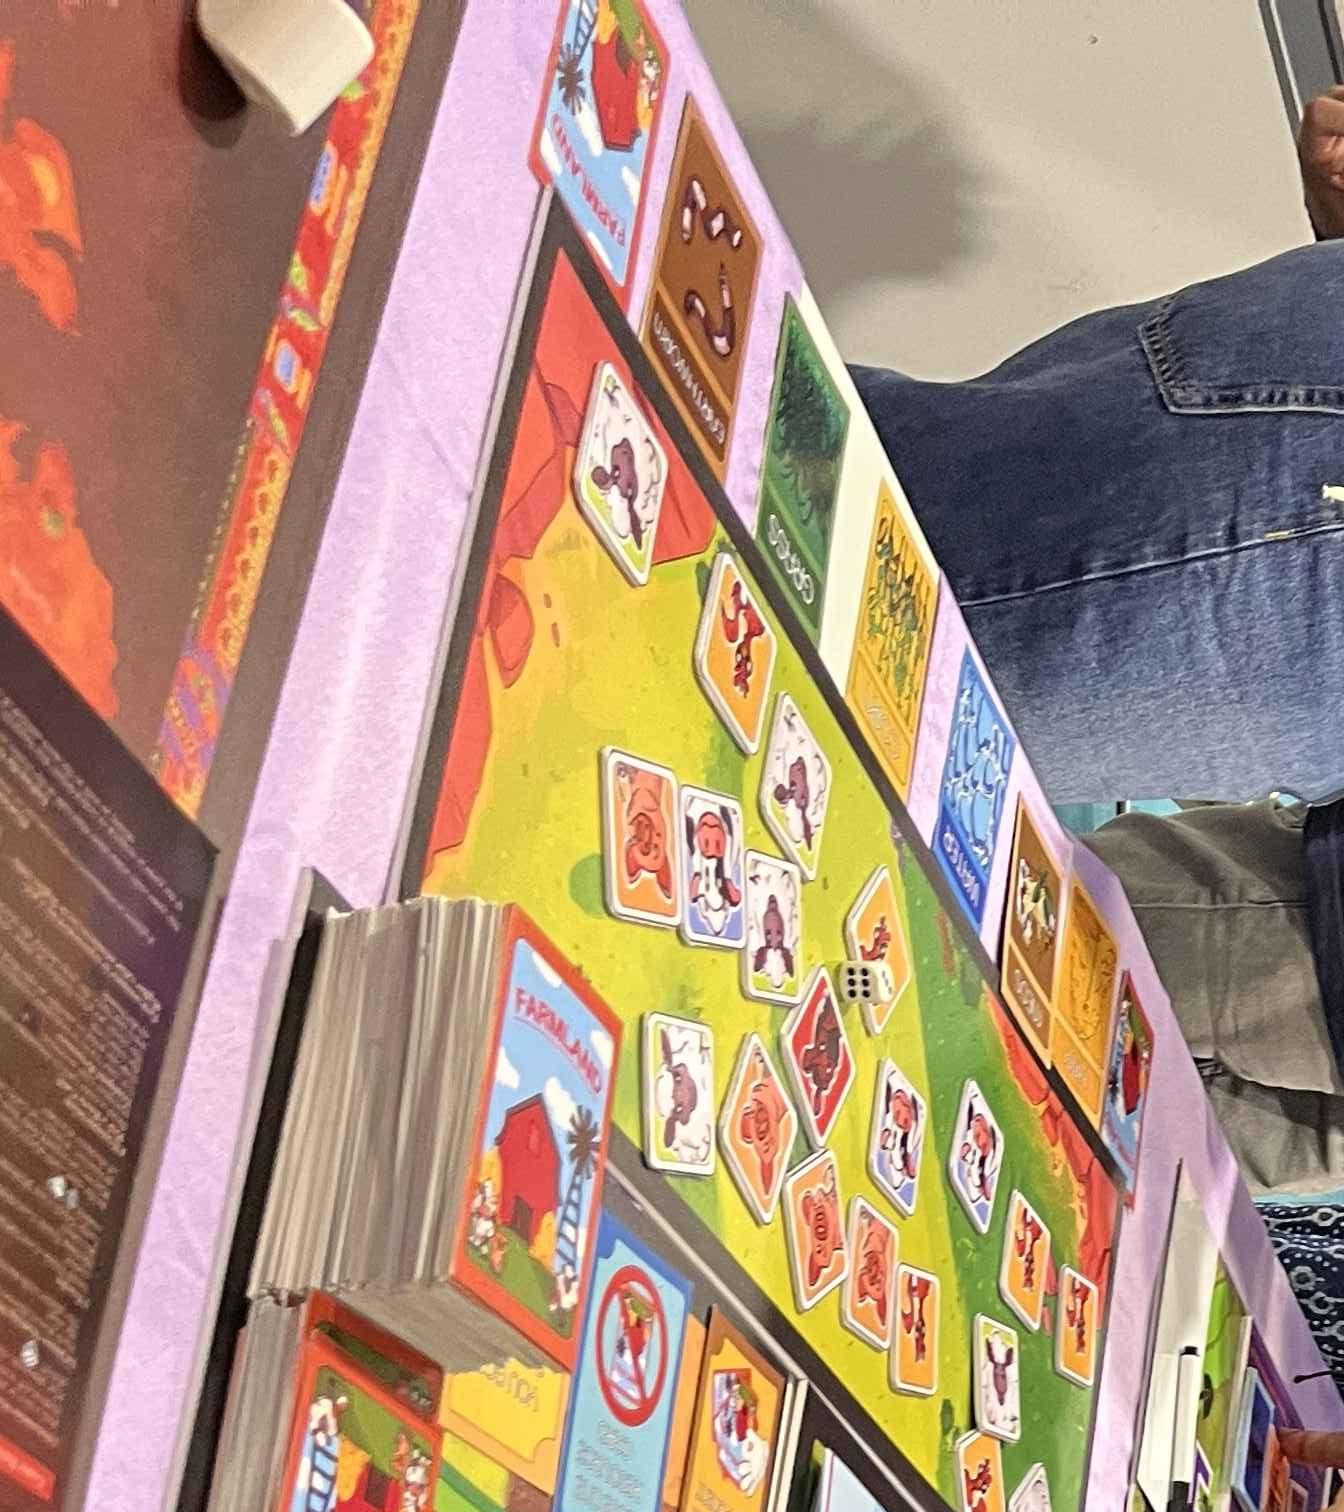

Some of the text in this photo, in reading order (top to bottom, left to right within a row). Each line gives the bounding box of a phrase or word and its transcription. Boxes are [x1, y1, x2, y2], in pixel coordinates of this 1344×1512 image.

[549, 112, 627, 248] FARMLAND
[767, 514, 817, 605] GRASS
[944, 829, 982, 905] WATER
[510, 984, 604, 1097] FARMLAND
